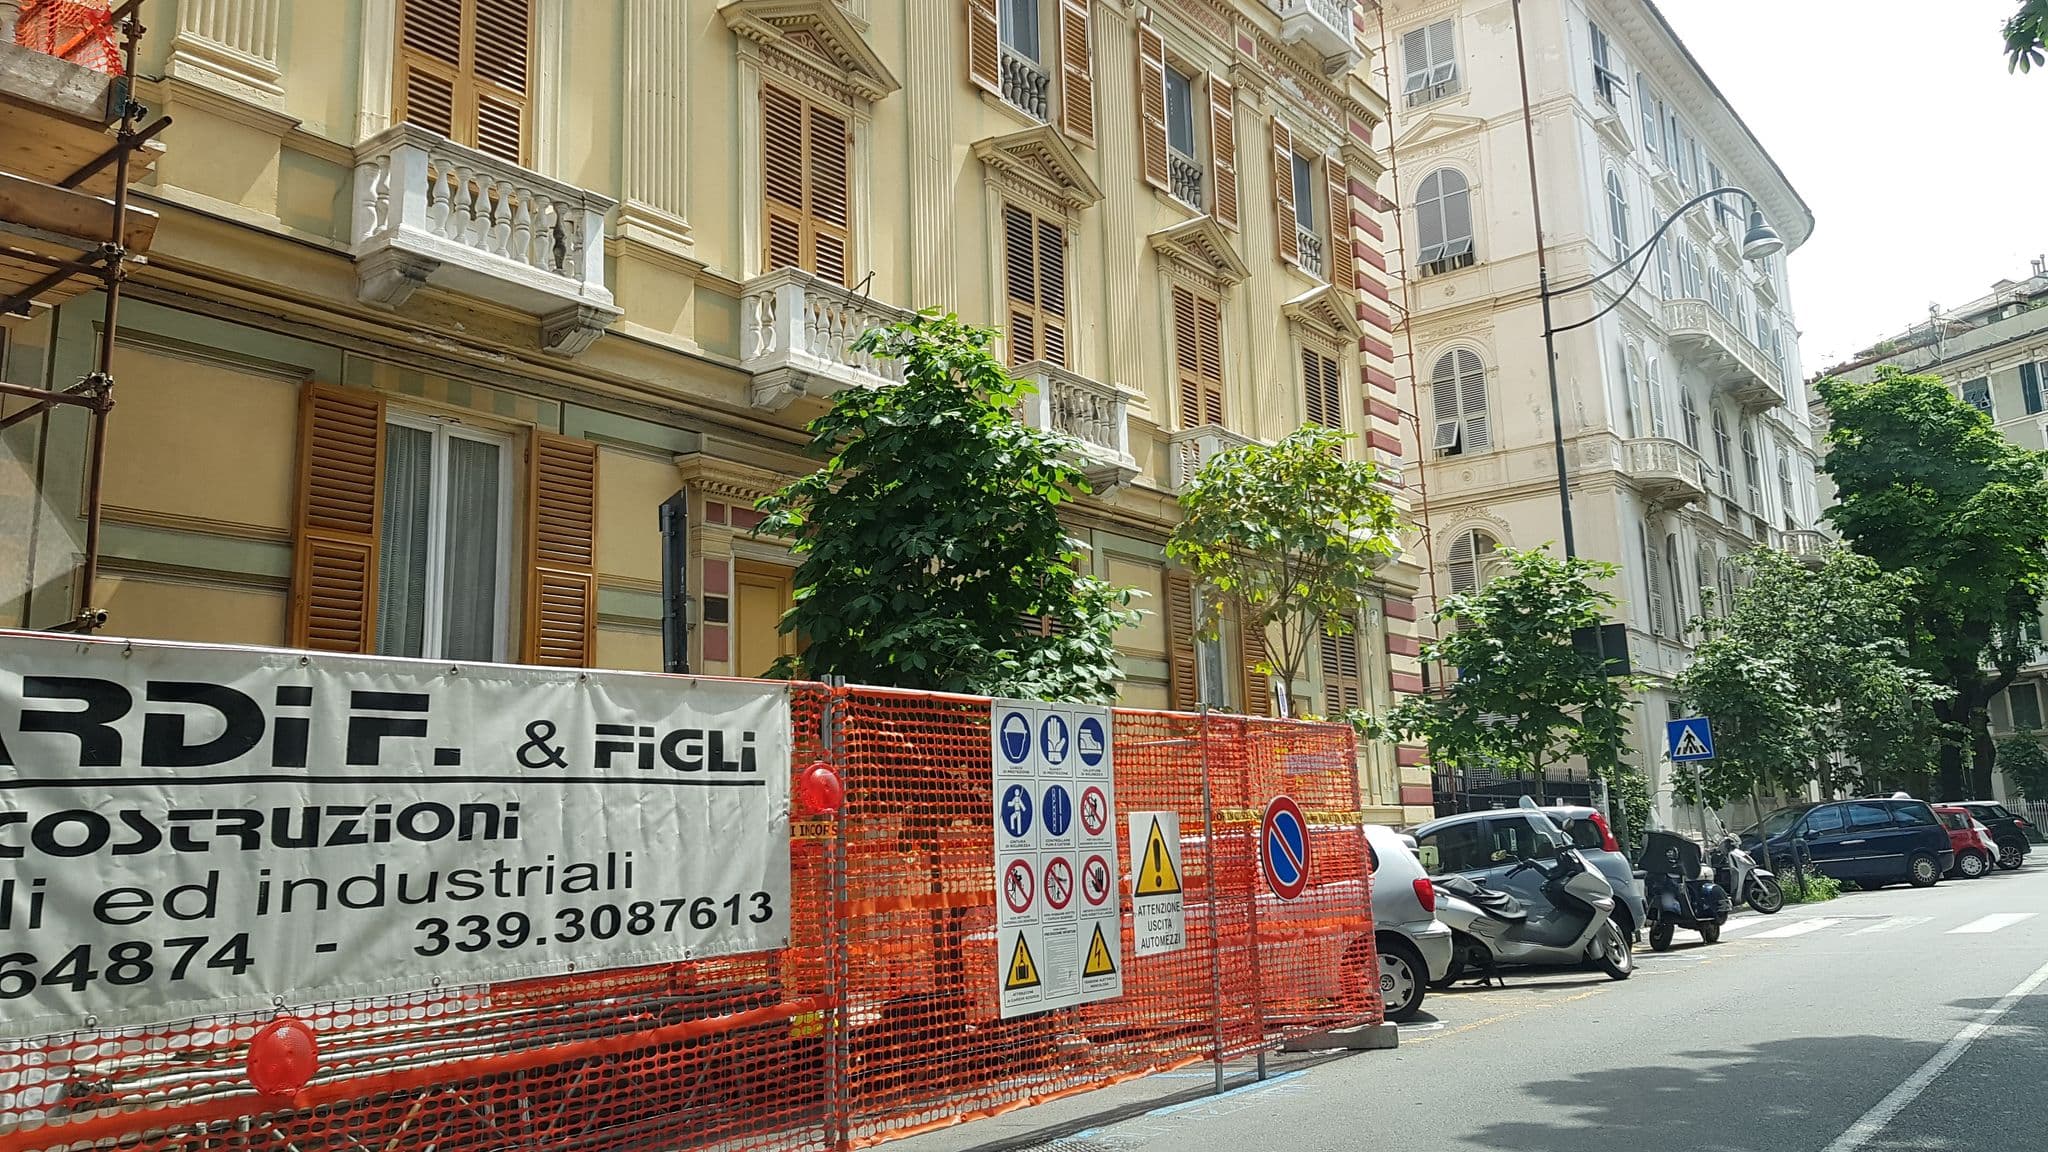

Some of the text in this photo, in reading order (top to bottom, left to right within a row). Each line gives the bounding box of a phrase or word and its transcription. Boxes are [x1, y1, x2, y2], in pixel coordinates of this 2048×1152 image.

[516, 719, 569, 769] &
[92, 870, 220, 926] ed
[256, 851, 634, 917] industriali
[1137, 901, 1181, 917] ATTENZIONE
[1147, 918, 1173, 932] USCITA
[0, 891, 774, 1000] 64874 - 339.3087613
[1140, 932, 1181, 950] AUTOMEZZI
